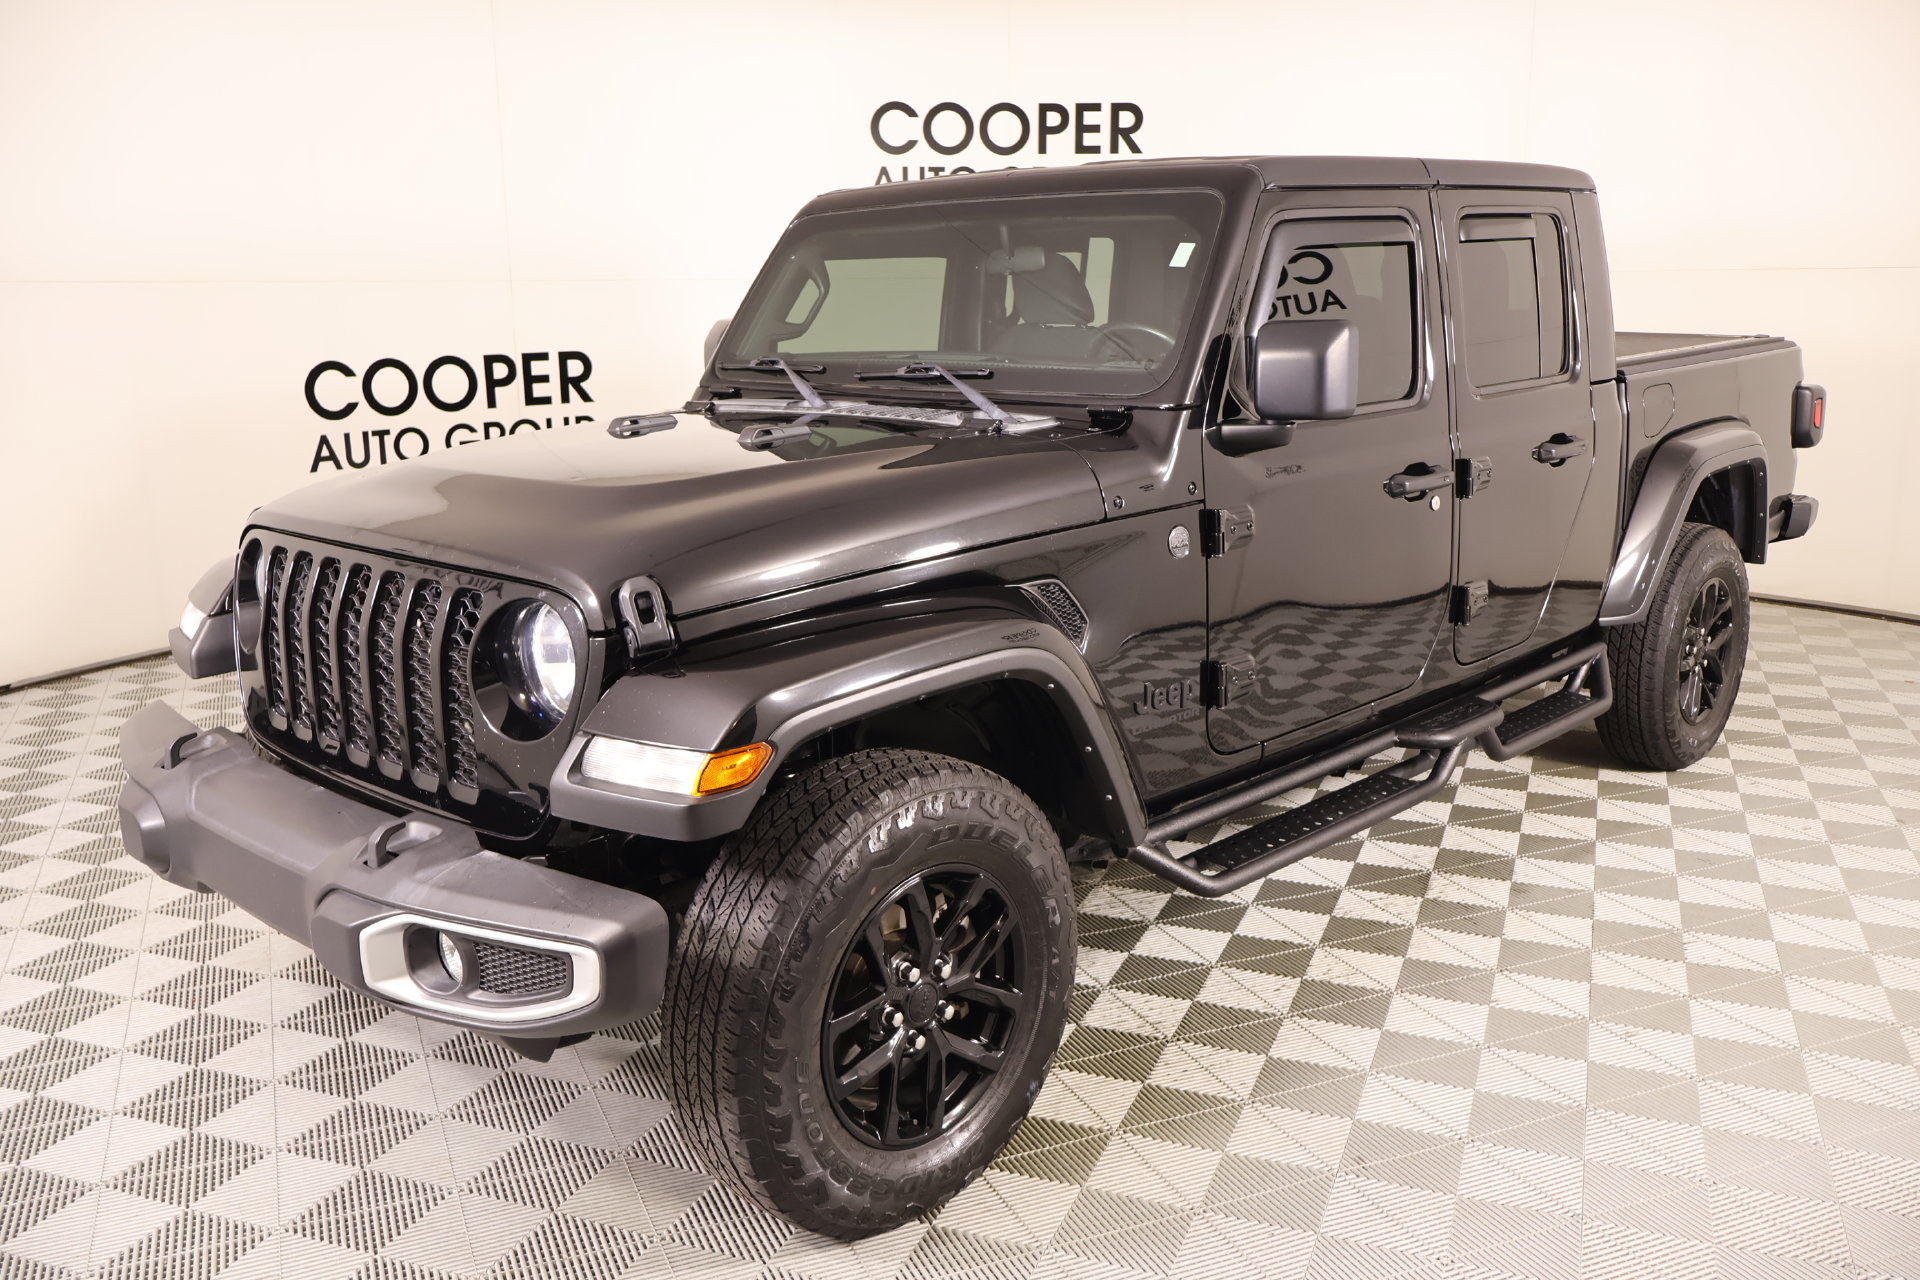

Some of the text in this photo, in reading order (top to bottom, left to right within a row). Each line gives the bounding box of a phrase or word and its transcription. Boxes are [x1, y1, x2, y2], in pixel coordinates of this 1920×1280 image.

[870, 101, 1143, 155] COOPER
[304, 350, 594, 420] COOPER
[310, 427, 429, 473] AUTO
[1133, 679, 1198, 716] Jeep
[925, 821, 1061, 928] DUELER
